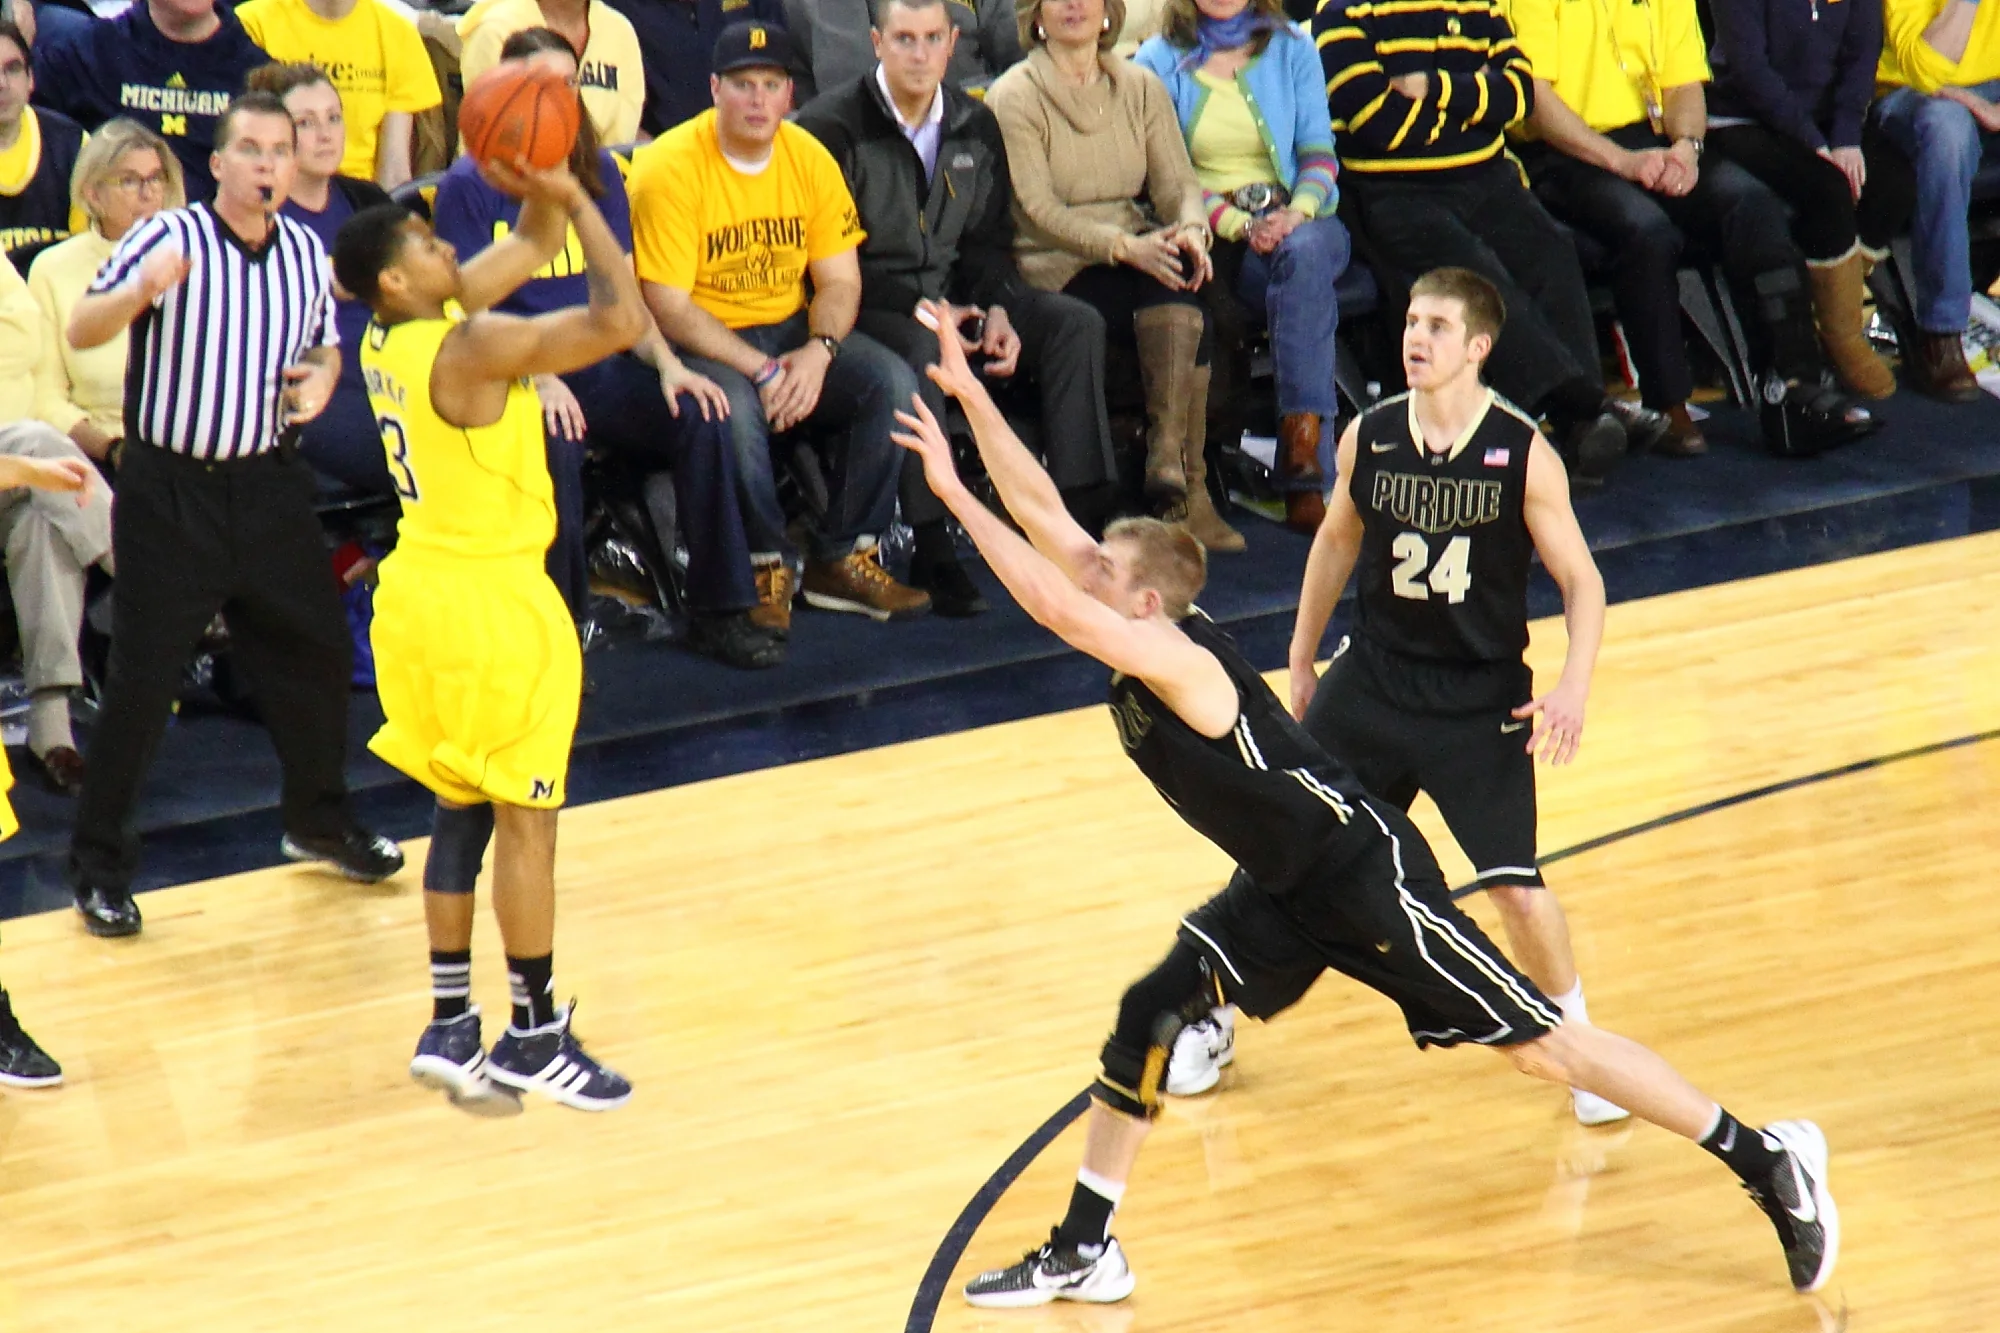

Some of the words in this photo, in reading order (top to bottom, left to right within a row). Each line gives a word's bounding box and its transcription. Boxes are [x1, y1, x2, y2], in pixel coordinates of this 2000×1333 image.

[121, 82, 230, 116] MICHIGAN
[161, 112, 187, 136] M
[1371, 470, 1502, 534] PURDUE
[1391, 531, 1472, 605] 24
[529, 778, 556, 800] M
